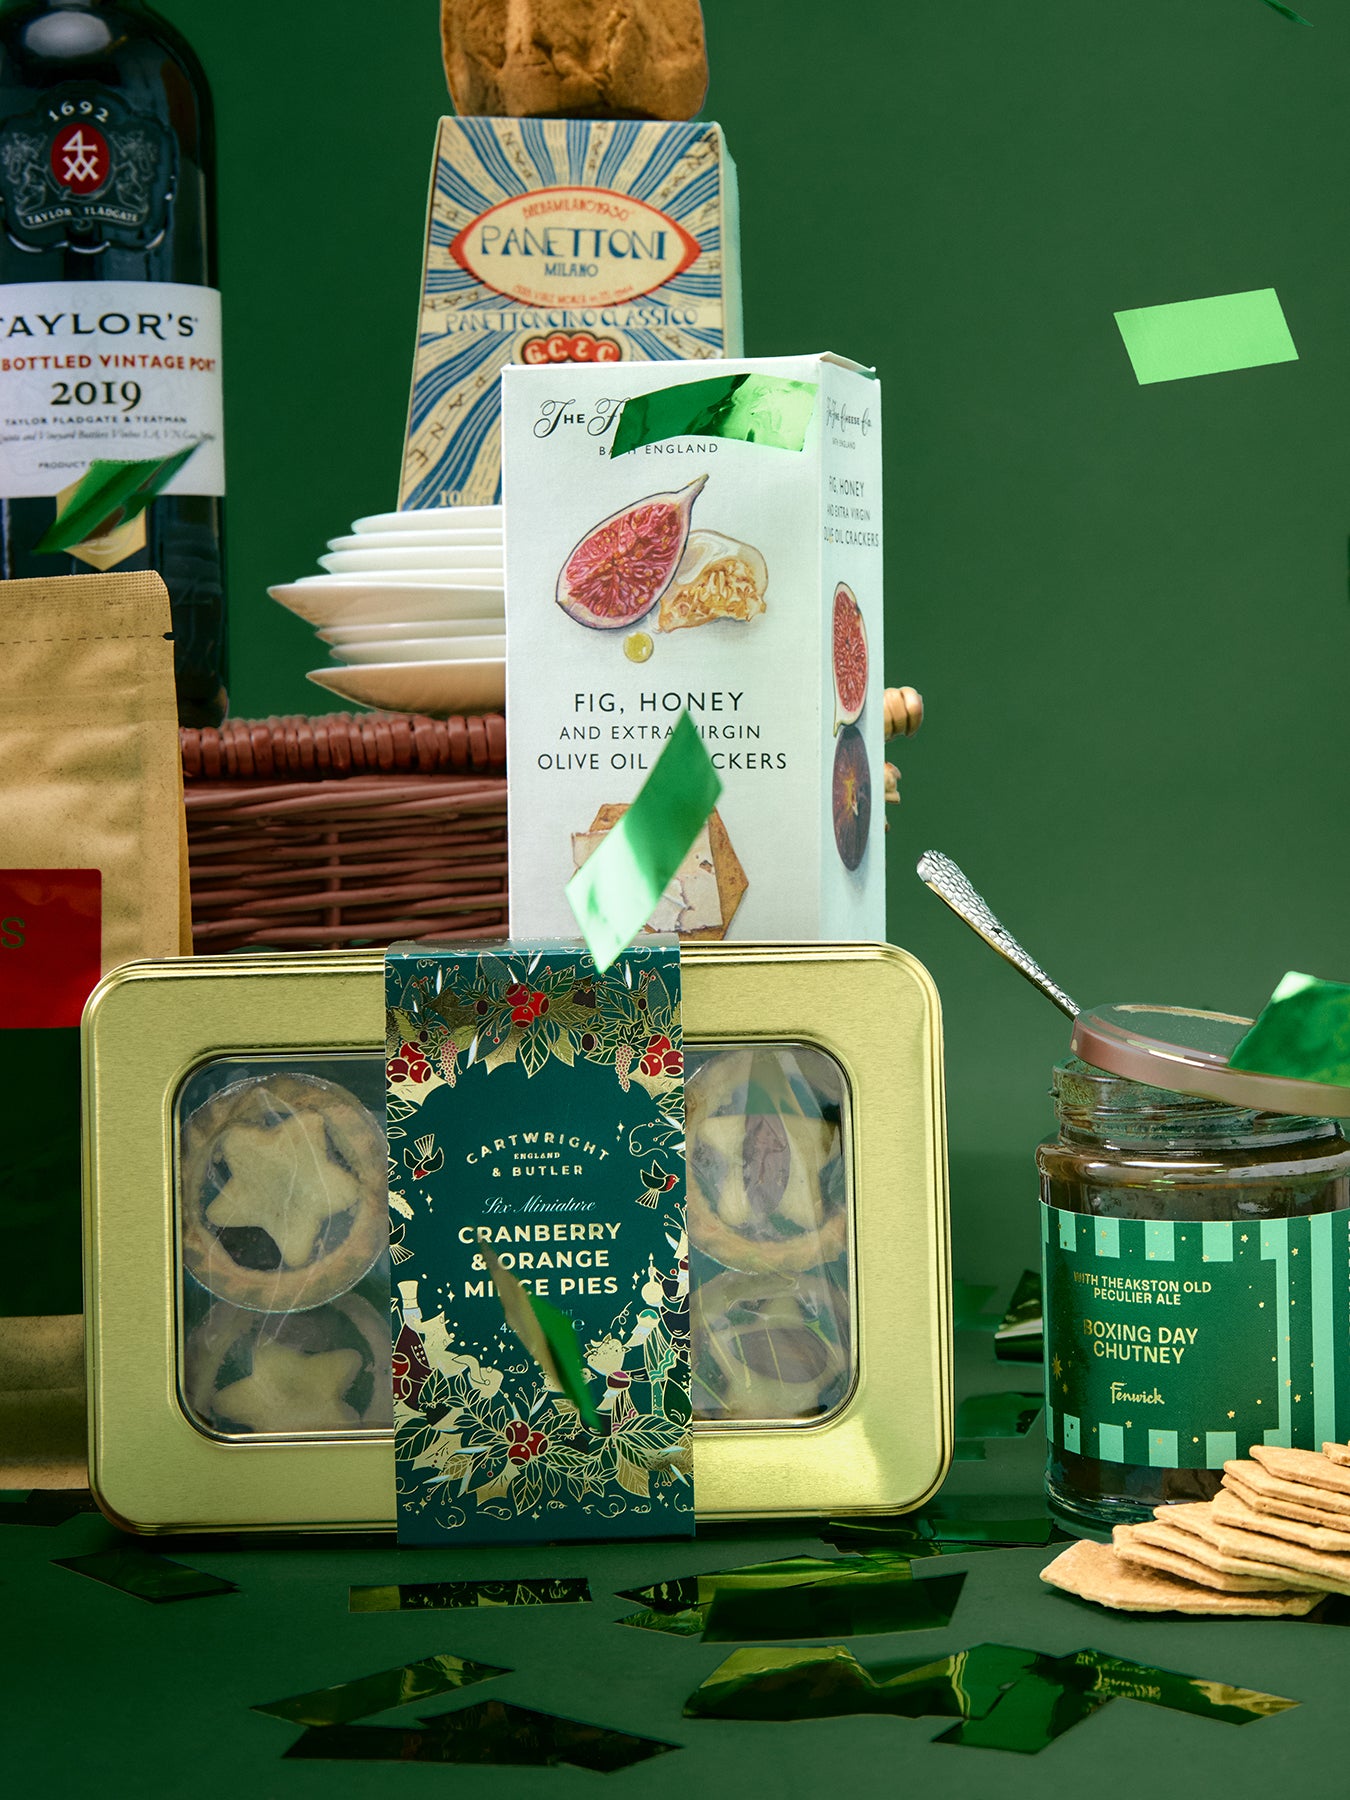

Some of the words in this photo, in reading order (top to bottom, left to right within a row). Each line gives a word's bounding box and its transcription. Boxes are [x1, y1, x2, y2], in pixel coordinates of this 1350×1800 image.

[48, 101, 109, 123] 1692
[27, 207, 73, 224] TAYLOR
[84, 206, 139, 223] FLADGATE
[480, 225, 668, 261] PANETTONI
[544, 262, 599, 277] MILANO
[0, 312, 194, 341] AYLOR'S
[446, 307, 597, 332] PANETTONCINO
[601, 306, 698, 329] CLASSICO
[1, 354, 92, 372] BOTTLED
[98, 354, 185, 370] VINTAGE
[50, 380, 142, 412] 2019
[5, 417, 47, 426] TAYLOR
[53, 415, 118, 424] FLADGATE
[136, 415, 187, 424] YEATMAN
[645, 443, 718, 455] ENGLAND
[38, 461, 86, 469] PRODUCT
[839, 478, 865, 498] HONEY
[834, 505, 849, 519] EXTRA
[850, 508, 871, 521] VIRGIN
[844, 530, 879, 548] CRACKERS
[574, 692, 625, 714] FIG,
[639, 691, 744, 713] HONEY
[559, 726, 601, 740] AND
[611, 725, 674, 740] EXTRA
[537, 753, 600, 770] OLIVE
[610, 753, 648, 769] OIL
[710, 752, 787, 769] CKERS
[465, 1131, 610, 1165] CARTWRIGHT
[513, 1151, 561, 1160] ENGLAND
[492, 1167, 501, 1177] &
[512, 1165, 583, 1177] BUTLER
[481, 1196, 512, 1215] Six
[513, 1194, 598, 1213] Miniature
[458, 1222, 622, 1244] CRANBERRY
[471, 1253, 488, 1271] &
[497, 1250, 610, 1270] ORANGE
[464, 1278, 550, 1298] MICE
[560, 1276, 619, 1295] PIES
[1073, 1271, 1099, 1286] WITH
[1101, 1275, 1179, 1293] THEAKSTON
[1183, 1281, 1212, 1293] OLD
[1094, 1287, 1152, 1304] PECULIER
[1156, 1293, 1182, 1305] ALE
[1083, 1318, 1152, 1343] BOXING
[1158, 1327, 1199, 1344] DAY
[1093, 1340, 1185, 1364] CHUTNEY
[1110, 1381, 1165, 1404] Fenwick
